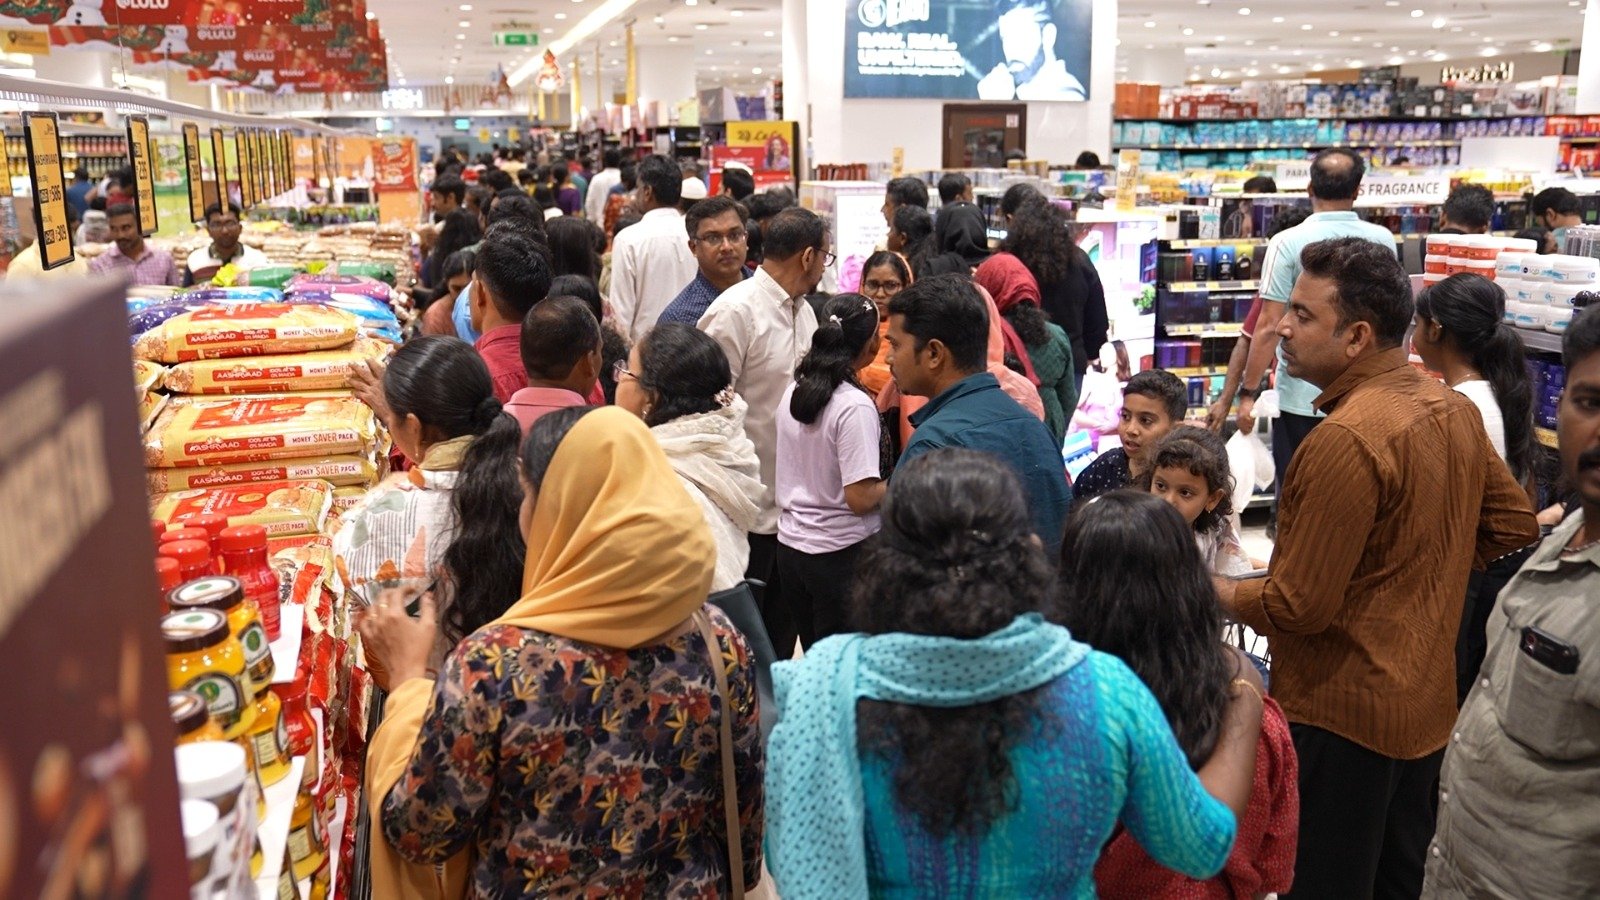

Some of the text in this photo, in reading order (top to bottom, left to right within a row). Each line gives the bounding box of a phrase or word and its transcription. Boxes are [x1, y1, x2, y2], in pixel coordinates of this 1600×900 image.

[1369, 182, 1440, 196] FRAGRANCE
[190, 333, 236, 342] AASHIRVAAD
[217, 370, 262, 379] AASHIRVAAD
[328, 365, 350, 374] SAVER
[313, 432, 337, 443] SAVER
[190, 441, 240, 452] AASHIRVAAD
[316, 465, 340, 476] SAVER
[193, 474, 243, 485] AASHIRVAAD
[270, 523, 291, 533] SAVER
